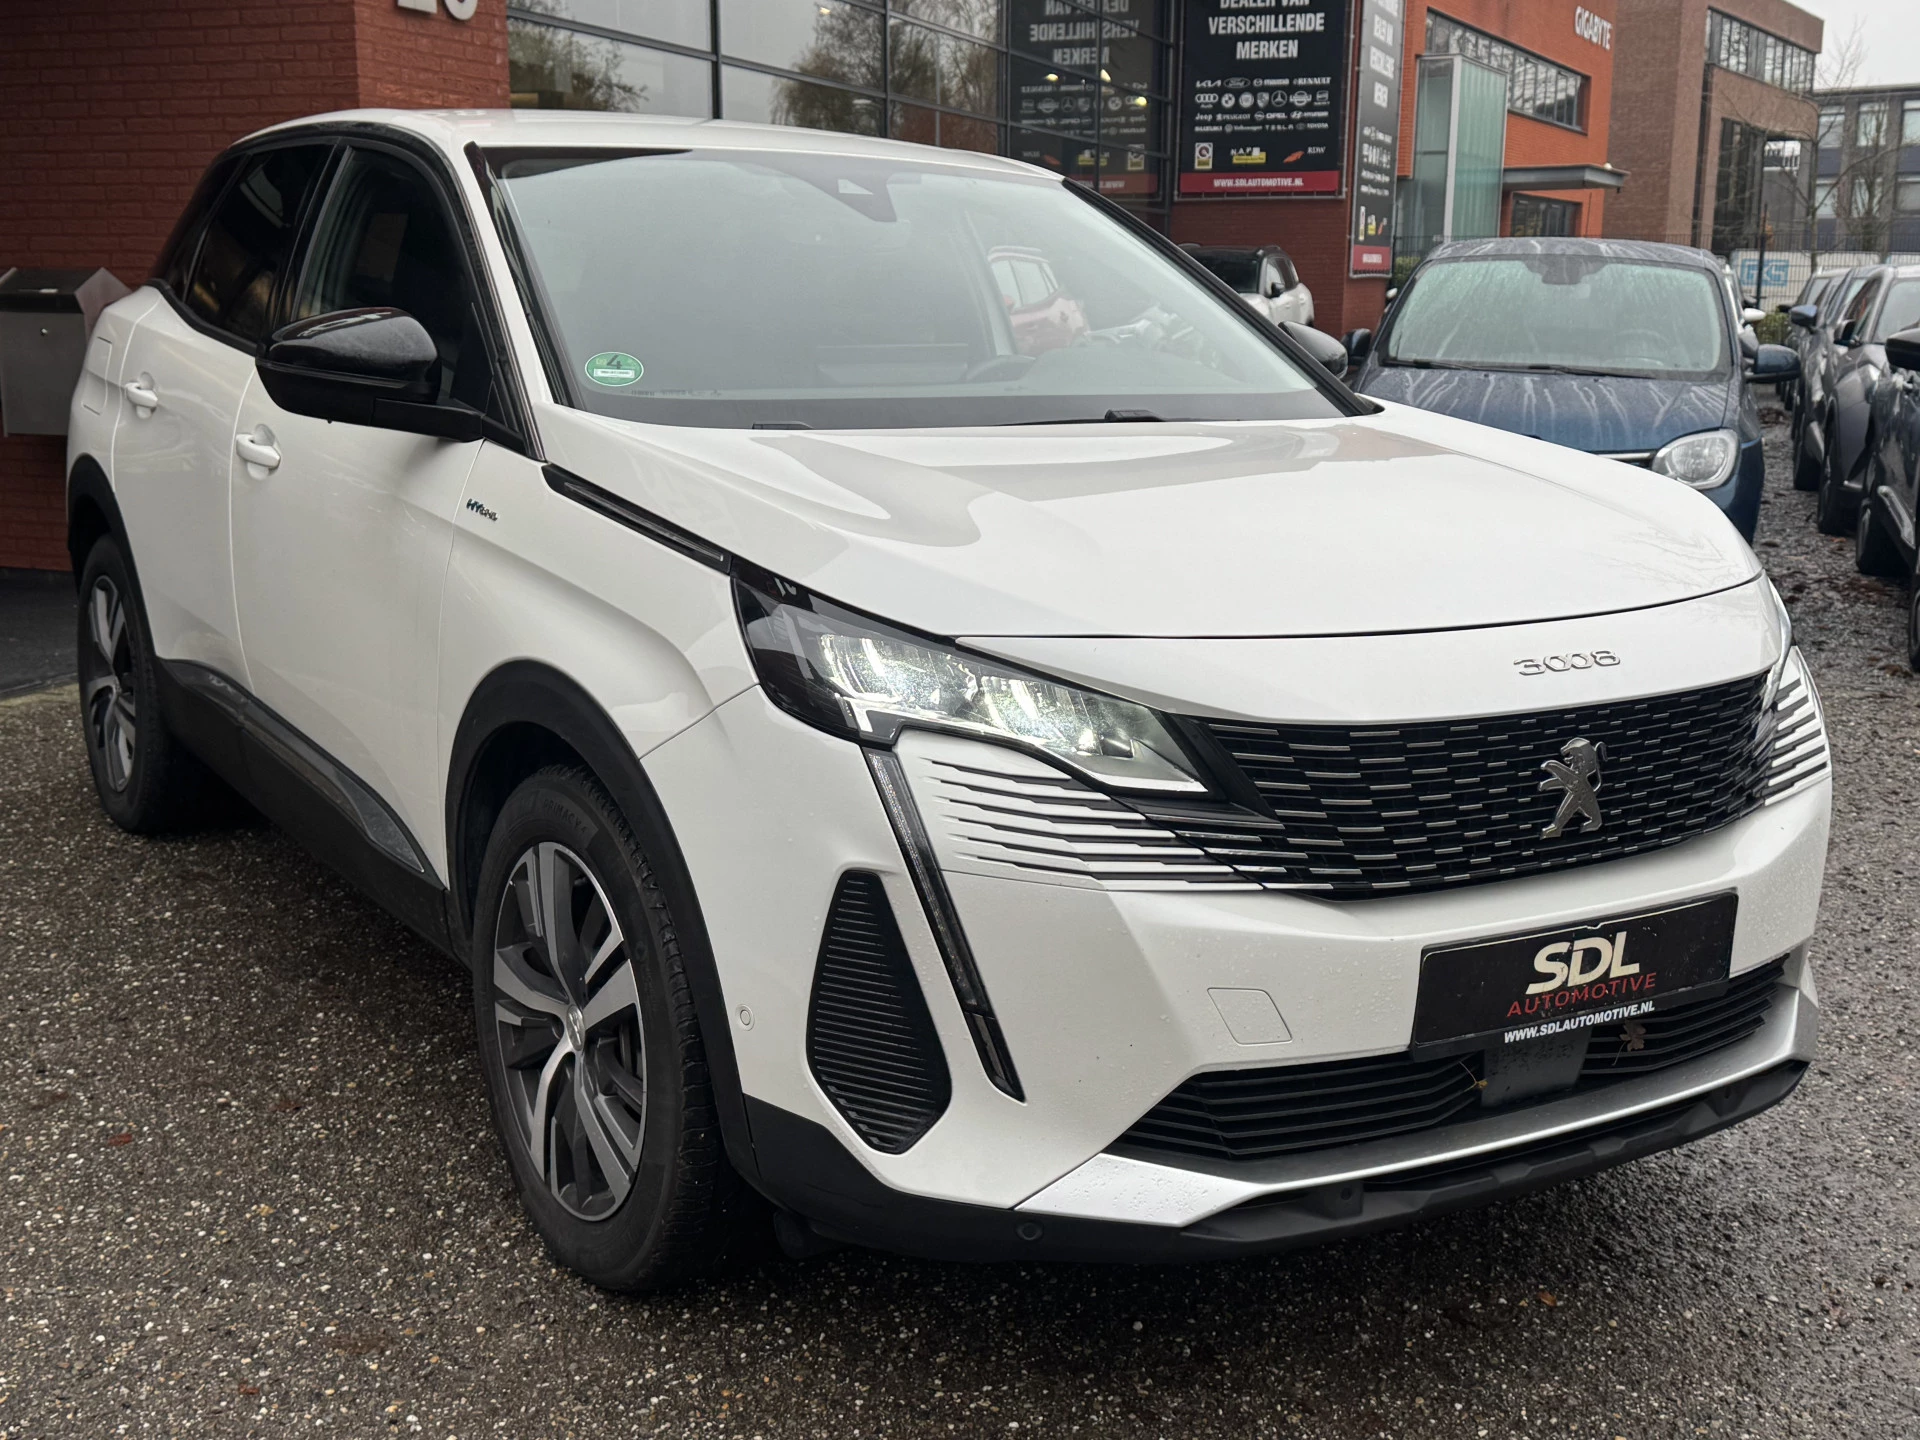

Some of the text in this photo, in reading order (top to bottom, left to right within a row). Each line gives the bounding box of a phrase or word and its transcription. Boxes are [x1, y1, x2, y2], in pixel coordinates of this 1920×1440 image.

[1208, 12, 1325, 35] VERSCHILLENDE
[1574, 5, 1613, 51] GIGABYTE
[1236, 39, 1299, 60] MERKEN
[1213, 177, 1304, 188] WWW.SDLAUTOMOTIVE.NL
[606, 354, 623, 370] 4
[1513, 650, 1621, 676] 3008
[1525, 931, 1640, 995] SDL
[1506, 972, 1657, 1018] AUTOMOTIVE
[1504, 1000, 1656, 1044] WWW.SDLAUTOMOTIVE.NL
